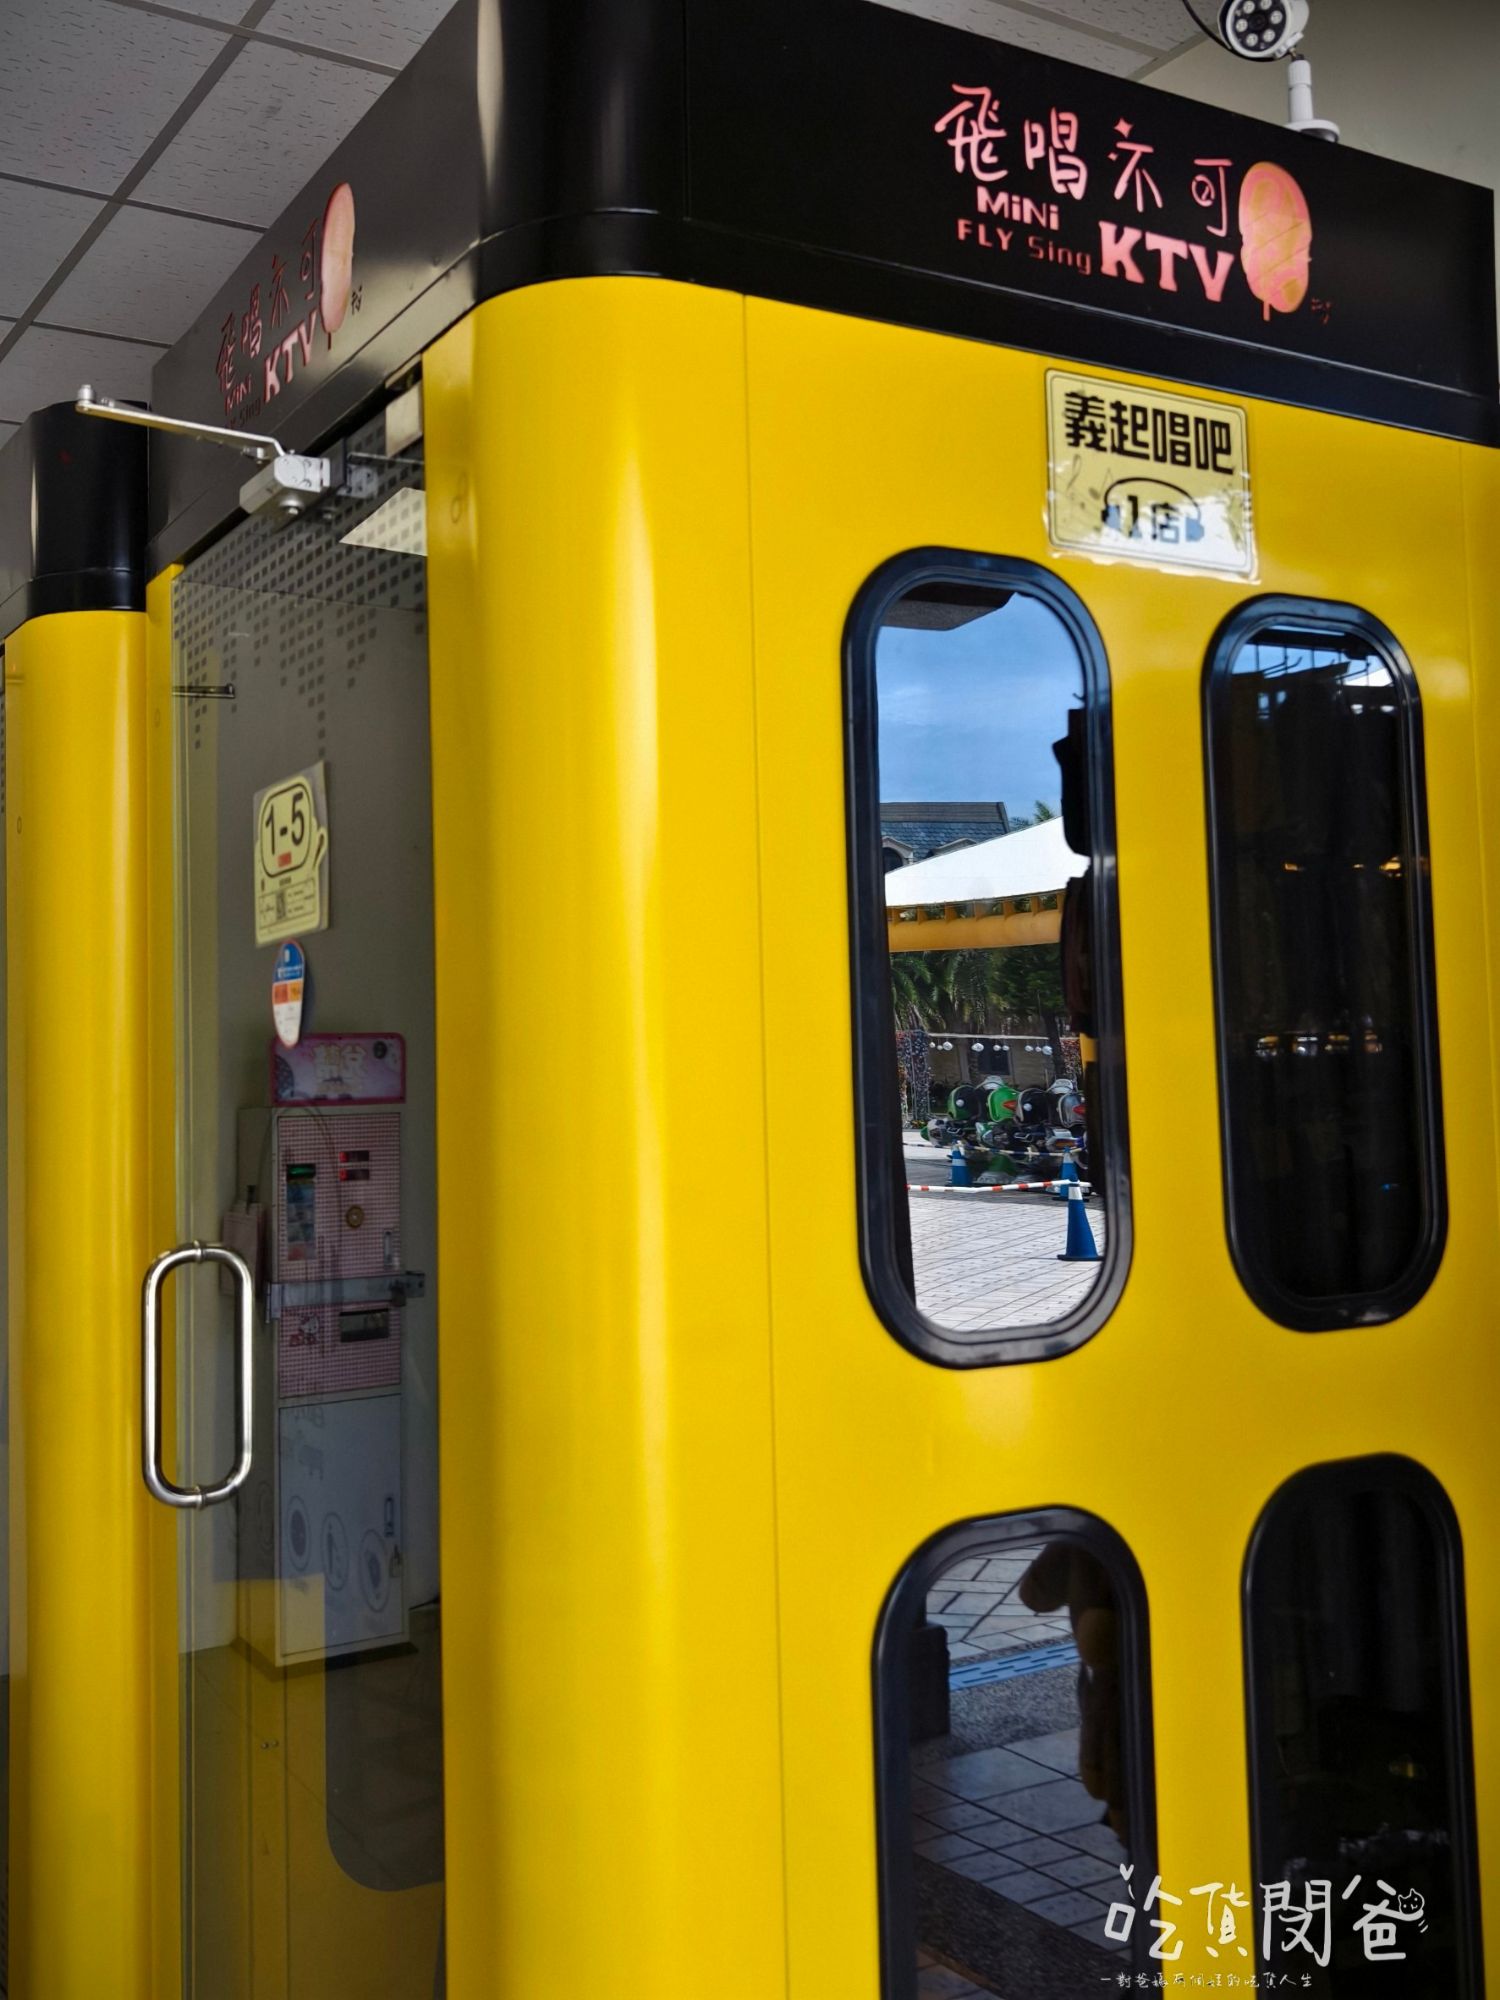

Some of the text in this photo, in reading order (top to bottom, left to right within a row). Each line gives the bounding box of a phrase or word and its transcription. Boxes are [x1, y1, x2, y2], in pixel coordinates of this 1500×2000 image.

[956, 218, 1092, 276] FLY Sing
[1098, 220, 1235, 303] KTV
[263, 307, 318, 404] KTV
[1064, 391, 1235, 476] 義起唱吧
